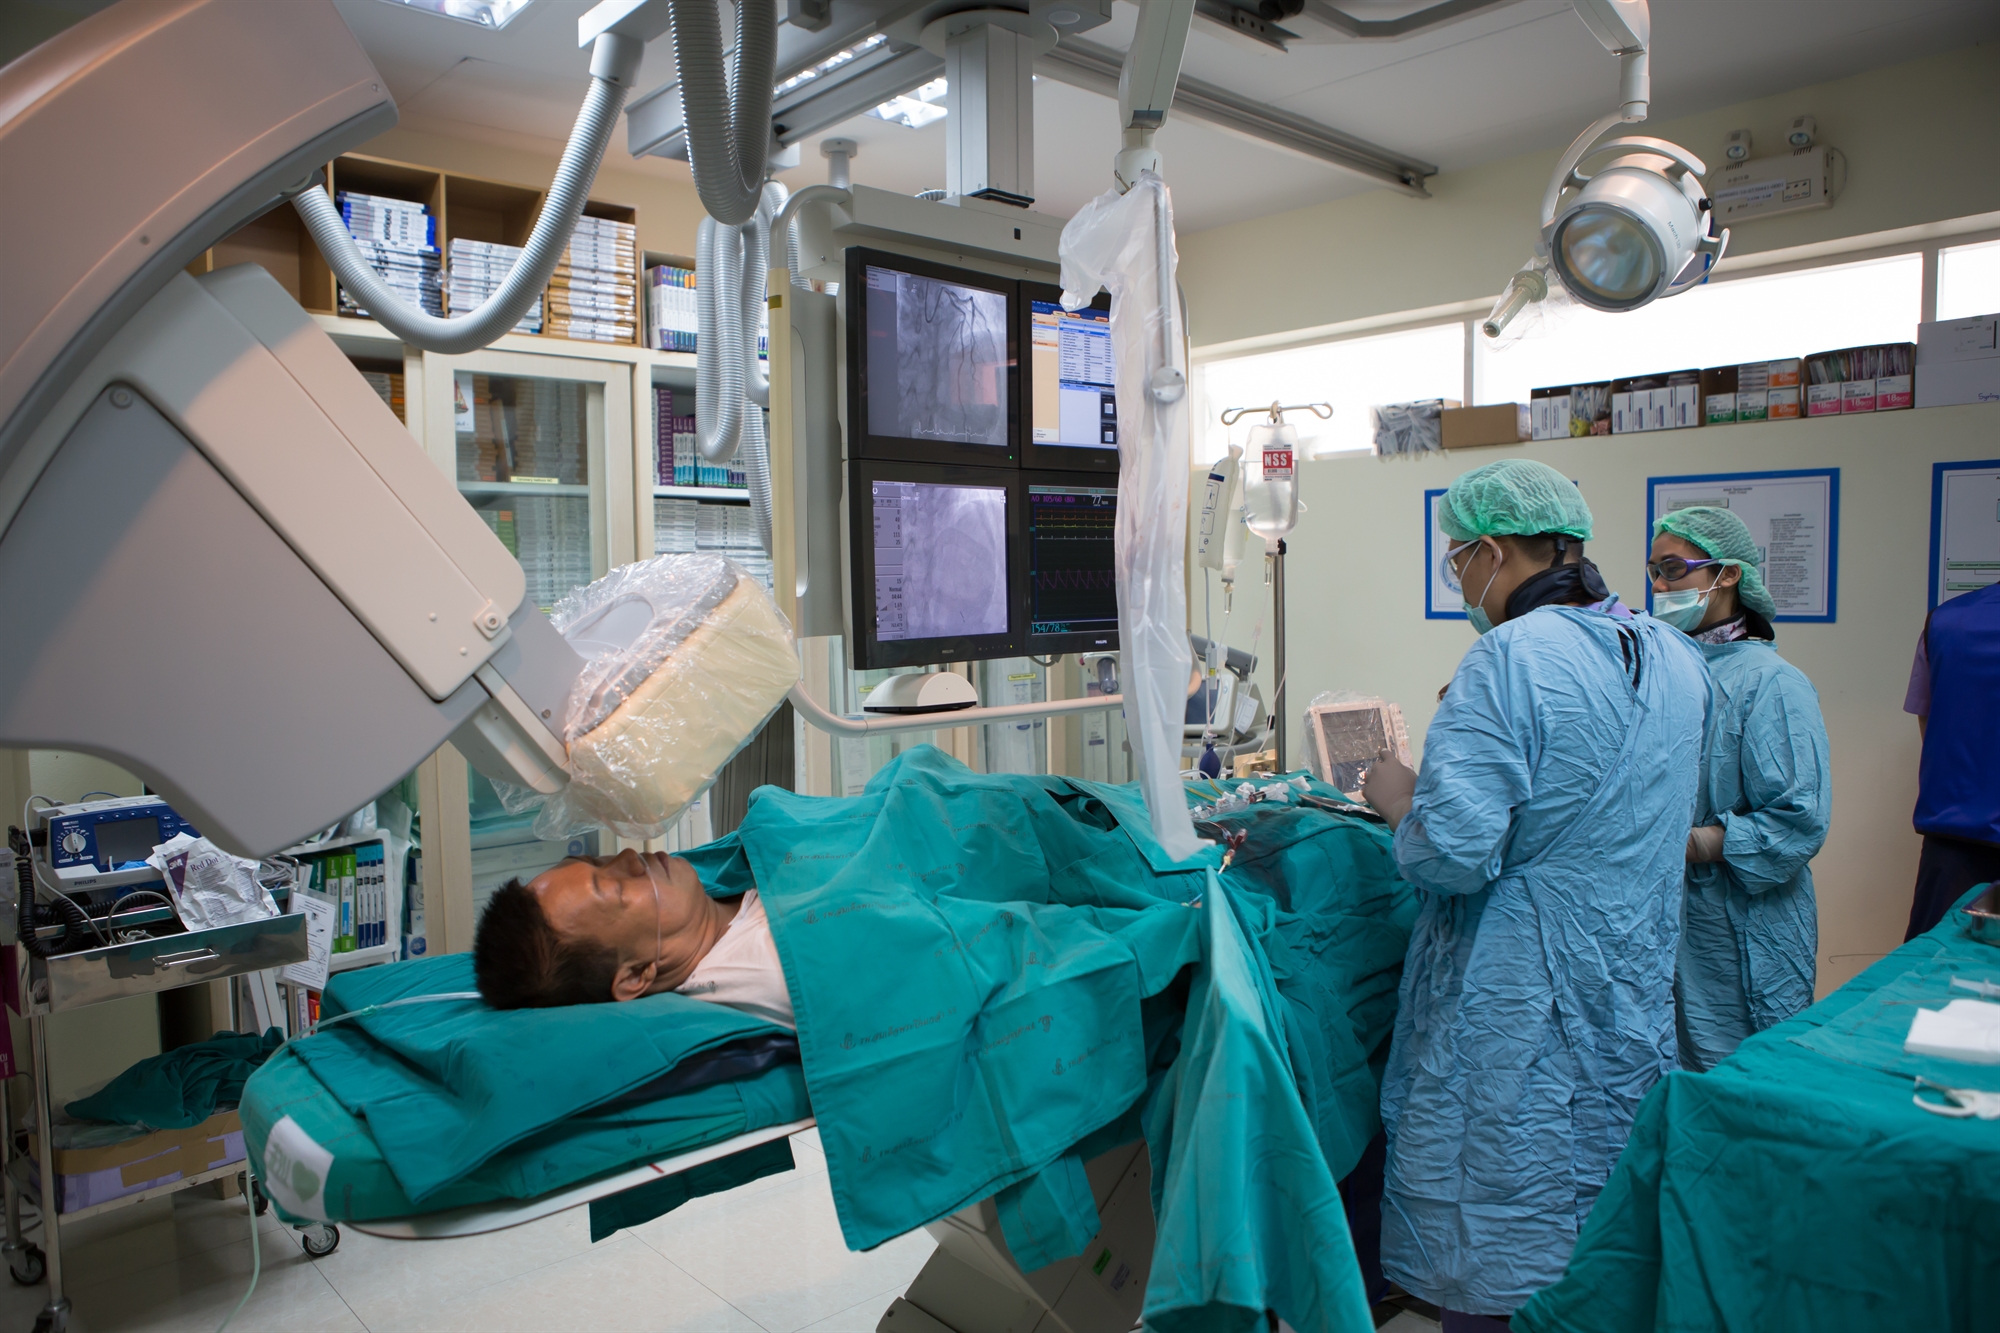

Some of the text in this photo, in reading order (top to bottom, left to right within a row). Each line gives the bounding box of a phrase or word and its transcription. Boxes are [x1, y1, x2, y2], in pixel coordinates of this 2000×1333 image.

[1264, 453, 1287, 467] NSS
[1091, 494, 1102, 505] 77
[1031, 623, 1060, 634] 154/78
[169, 858, 183, 870] 3M
[190, 857, 219, 872] Red Dot
[74, 878, 97, 886] PHILIPS
